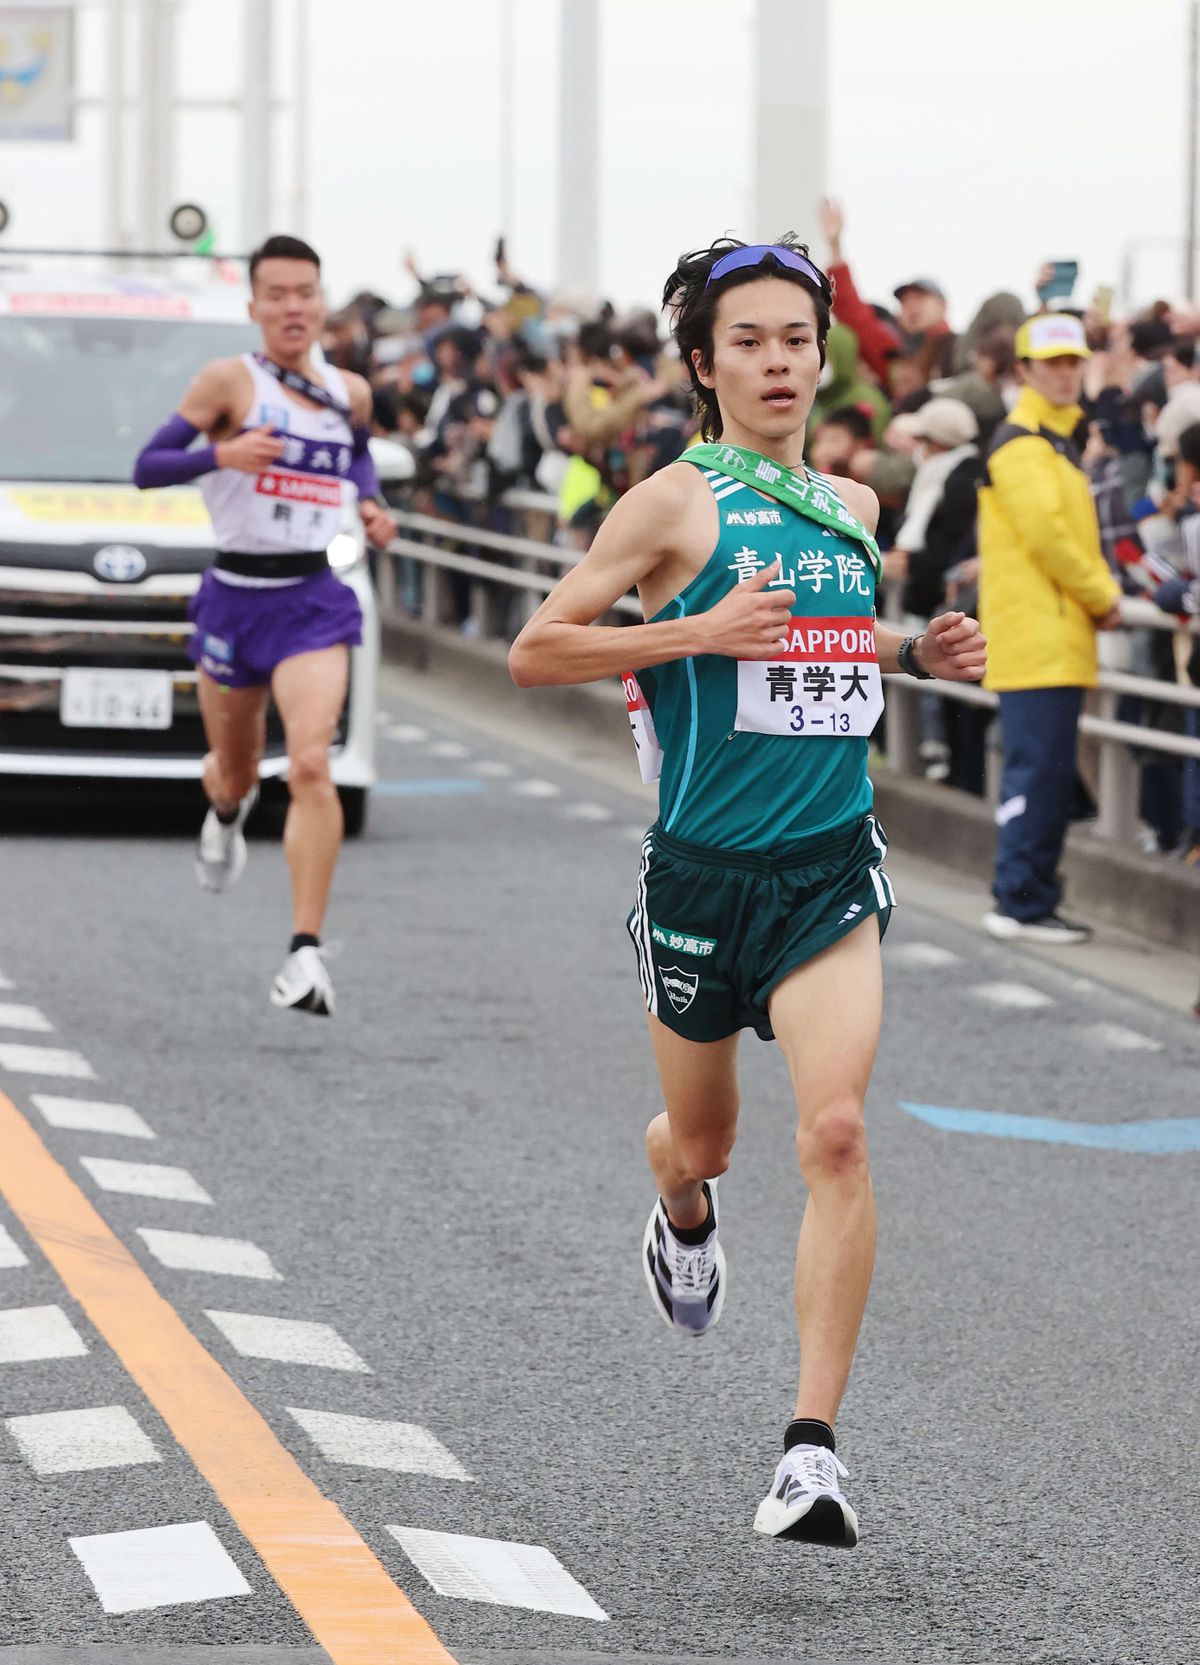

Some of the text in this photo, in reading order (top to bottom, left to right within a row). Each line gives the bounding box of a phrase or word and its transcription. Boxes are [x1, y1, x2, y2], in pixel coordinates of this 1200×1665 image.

[727, 546, 871, 596] 青山学院
[765, 665, 869, 702] 青学大
[669, 933, 715, 956] 妙高市
